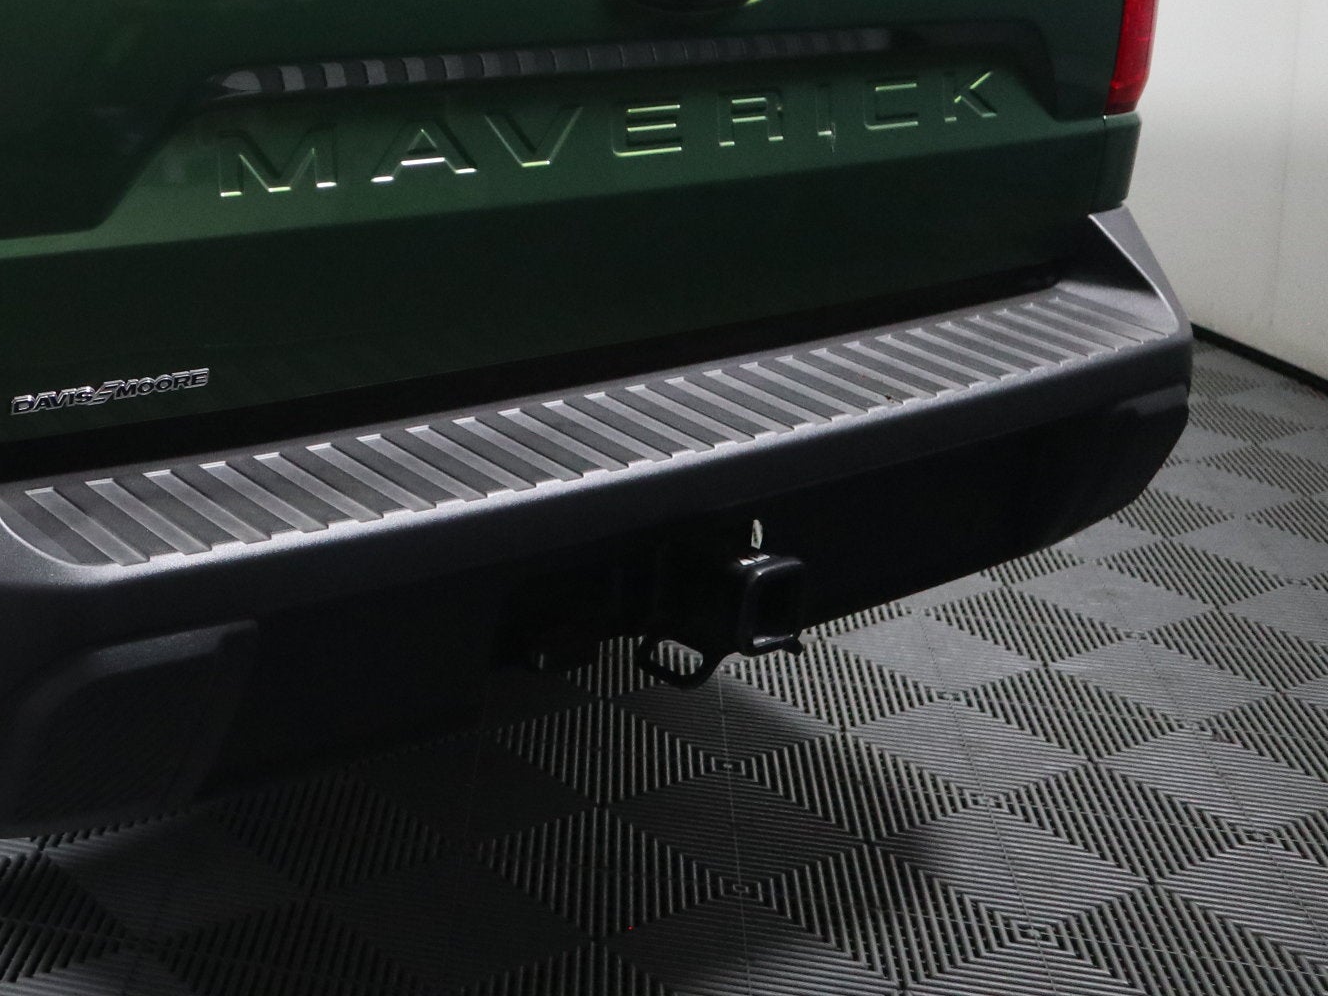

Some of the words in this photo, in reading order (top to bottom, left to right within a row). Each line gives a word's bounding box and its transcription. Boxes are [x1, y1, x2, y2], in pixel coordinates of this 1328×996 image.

[217, 70, 998, 198] MAVERICK
[11, 386, 95, 415] DAVIS
[114, 367, 210, 400] MOORE
